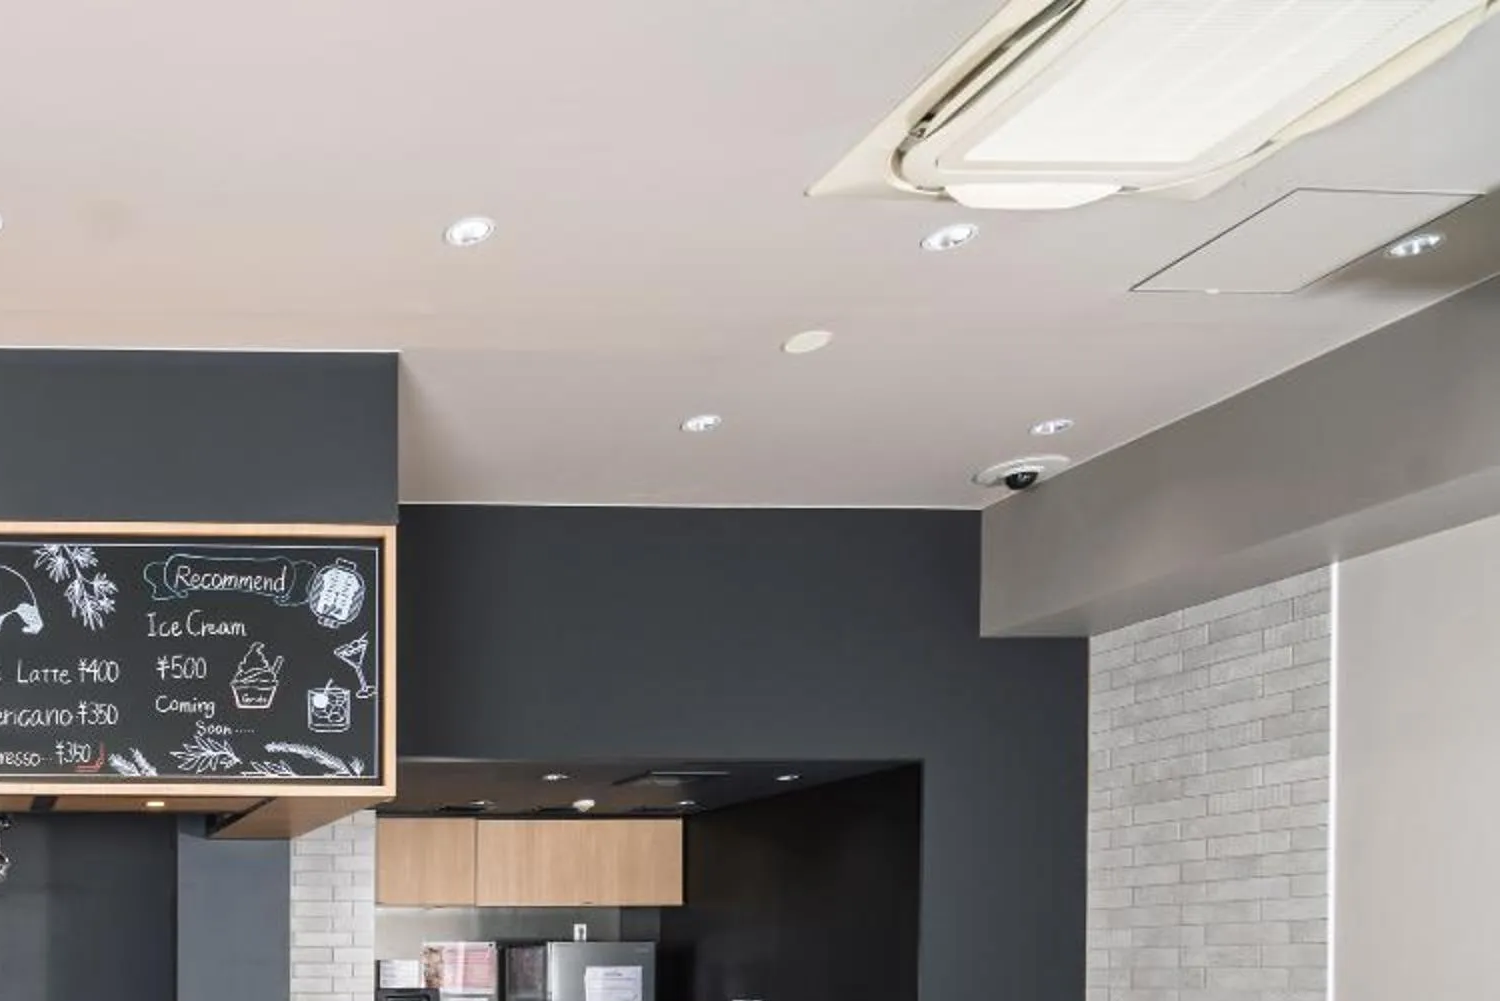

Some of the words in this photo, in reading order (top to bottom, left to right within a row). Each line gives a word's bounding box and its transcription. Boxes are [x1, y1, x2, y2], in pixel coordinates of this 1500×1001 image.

[174, 565, 287, 591] Recommend
[146, 612, 182, 637] Ice
[186, 609, 247, 637] Cream
[17, 659, 72, 684] Latte
[77, 657, 120, 683] ¥400
[156, 654, 207, 681] ¥500
[76, 700, 119, 726] ¥350
[155, 695, 215, 719] Coming
[55, 740, 92, 765] ¥350
